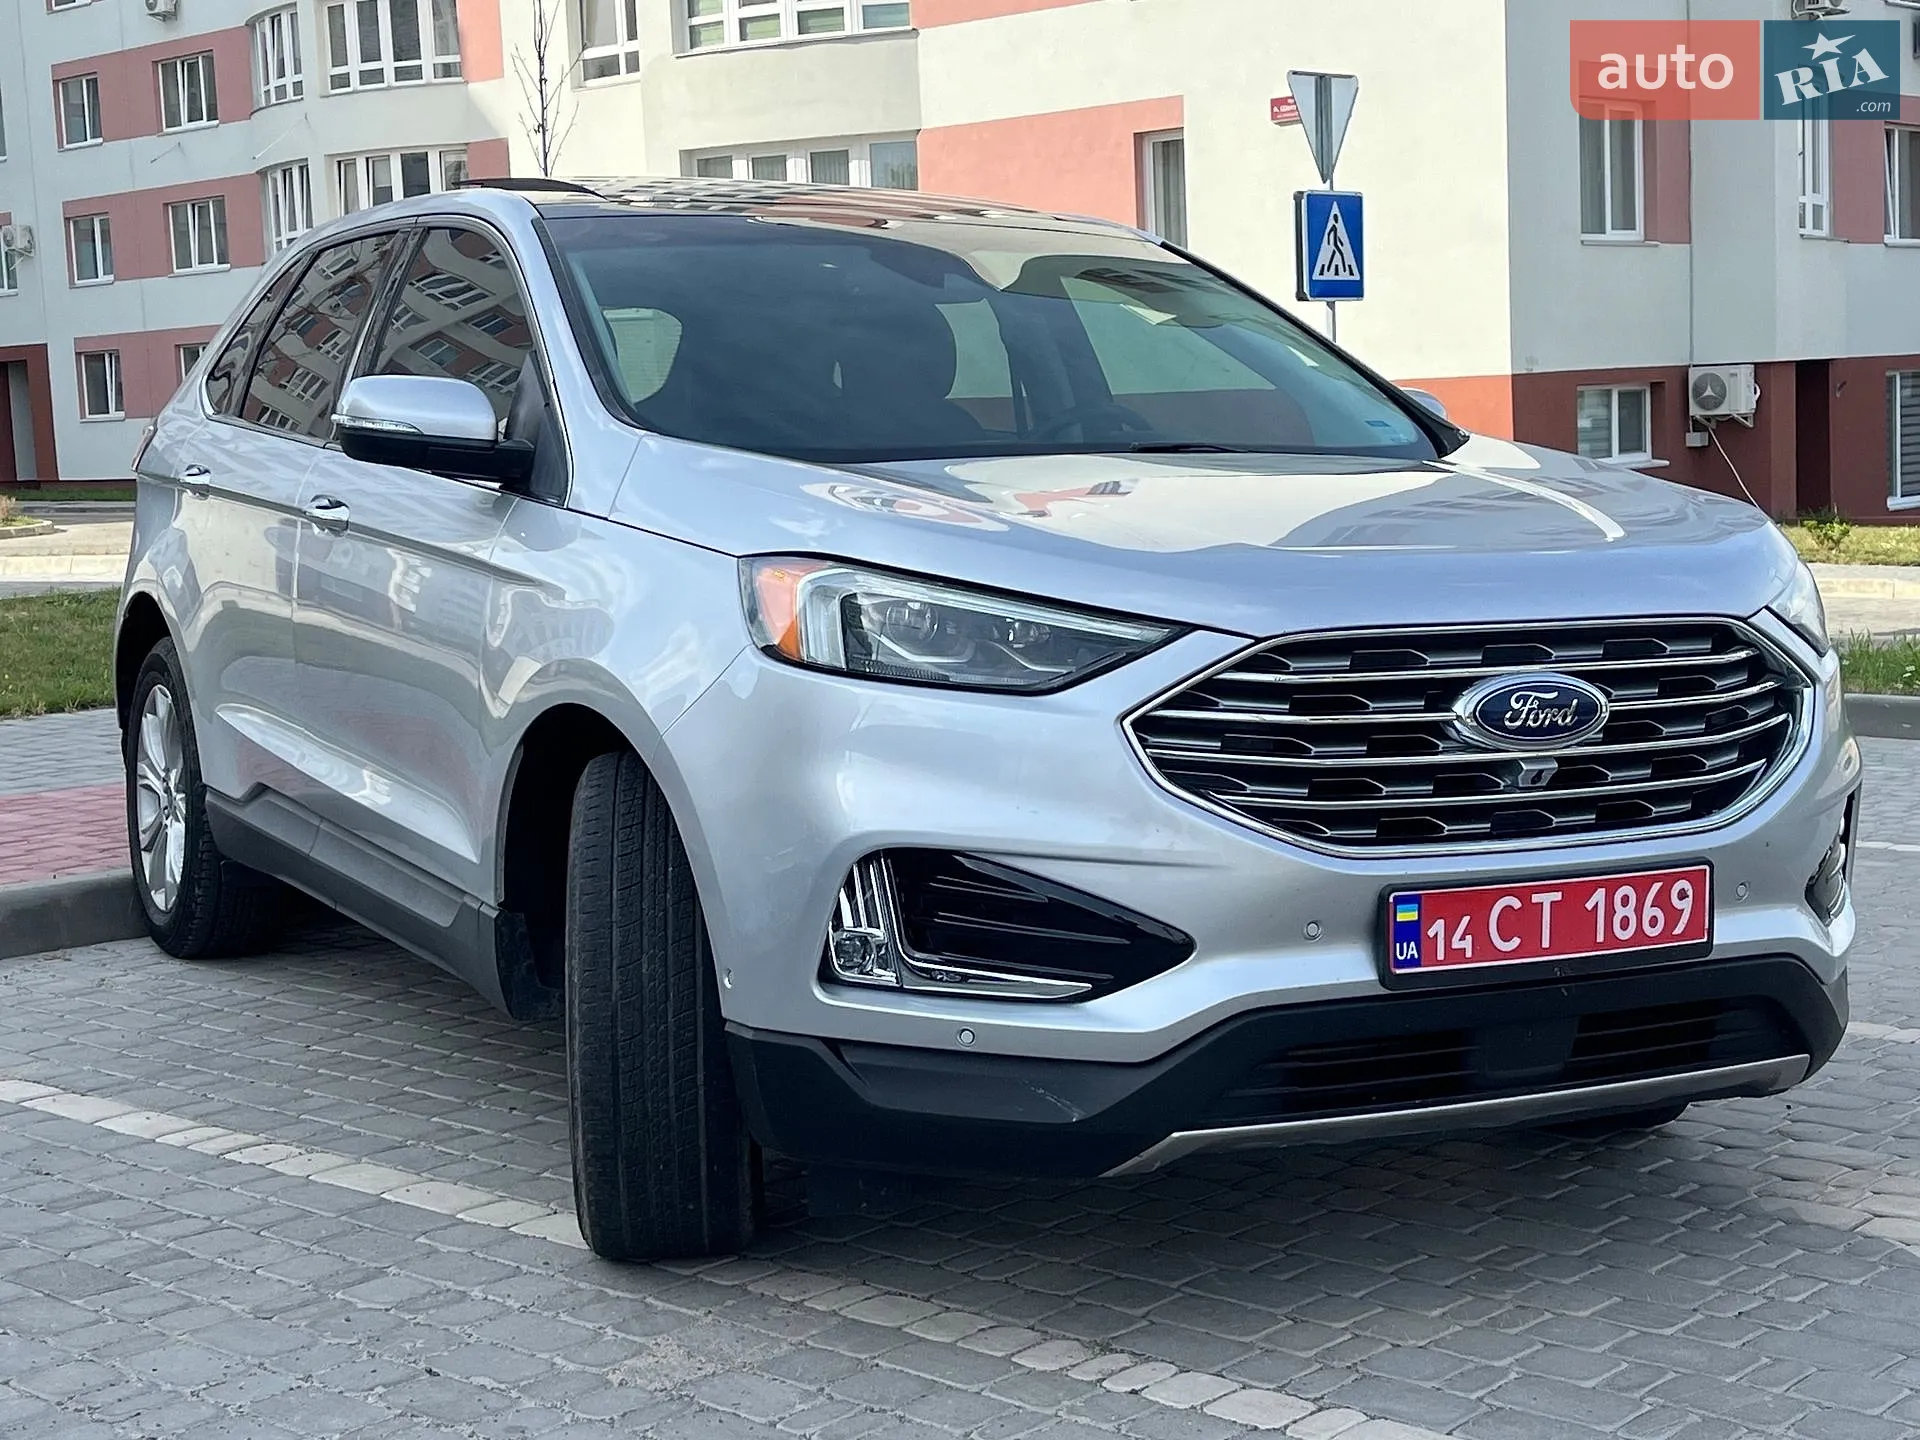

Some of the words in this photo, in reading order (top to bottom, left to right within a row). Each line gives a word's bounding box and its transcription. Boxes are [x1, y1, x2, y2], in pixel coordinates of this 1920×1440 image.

[1504, 691, 1579, 729] Ford
[1427, 915, 1473, 961] 14
[1488, 891, 1563, 952] CT
[1584, 879, 1695, 944] 1869
[1396, 941, 1419, 961] UA
